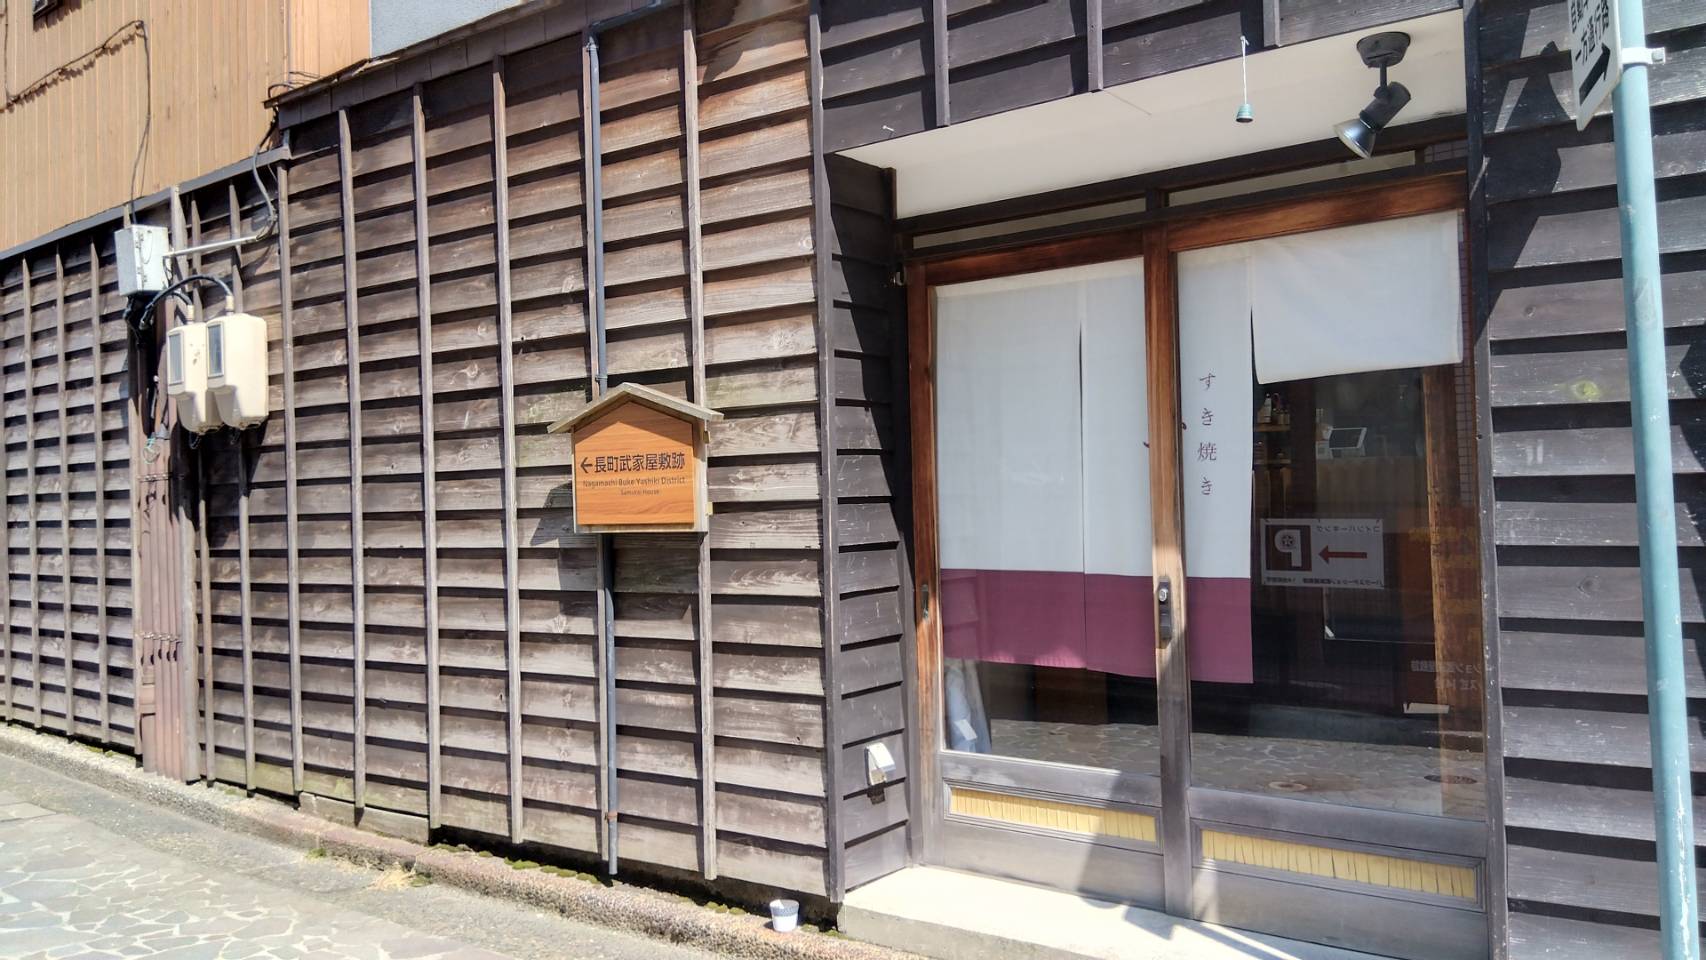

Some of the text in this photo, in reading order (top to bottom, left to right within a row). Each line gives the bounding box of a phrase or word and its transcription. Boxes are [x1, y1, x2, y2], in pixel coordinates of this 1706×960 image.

[1197, 372, 1217, 496] すき焼き
[595, 452, 686, 473] 長町武家屋敷跡
[583, 480, 617, 489] Nagamachi
[661, 476, 686, 485] District
